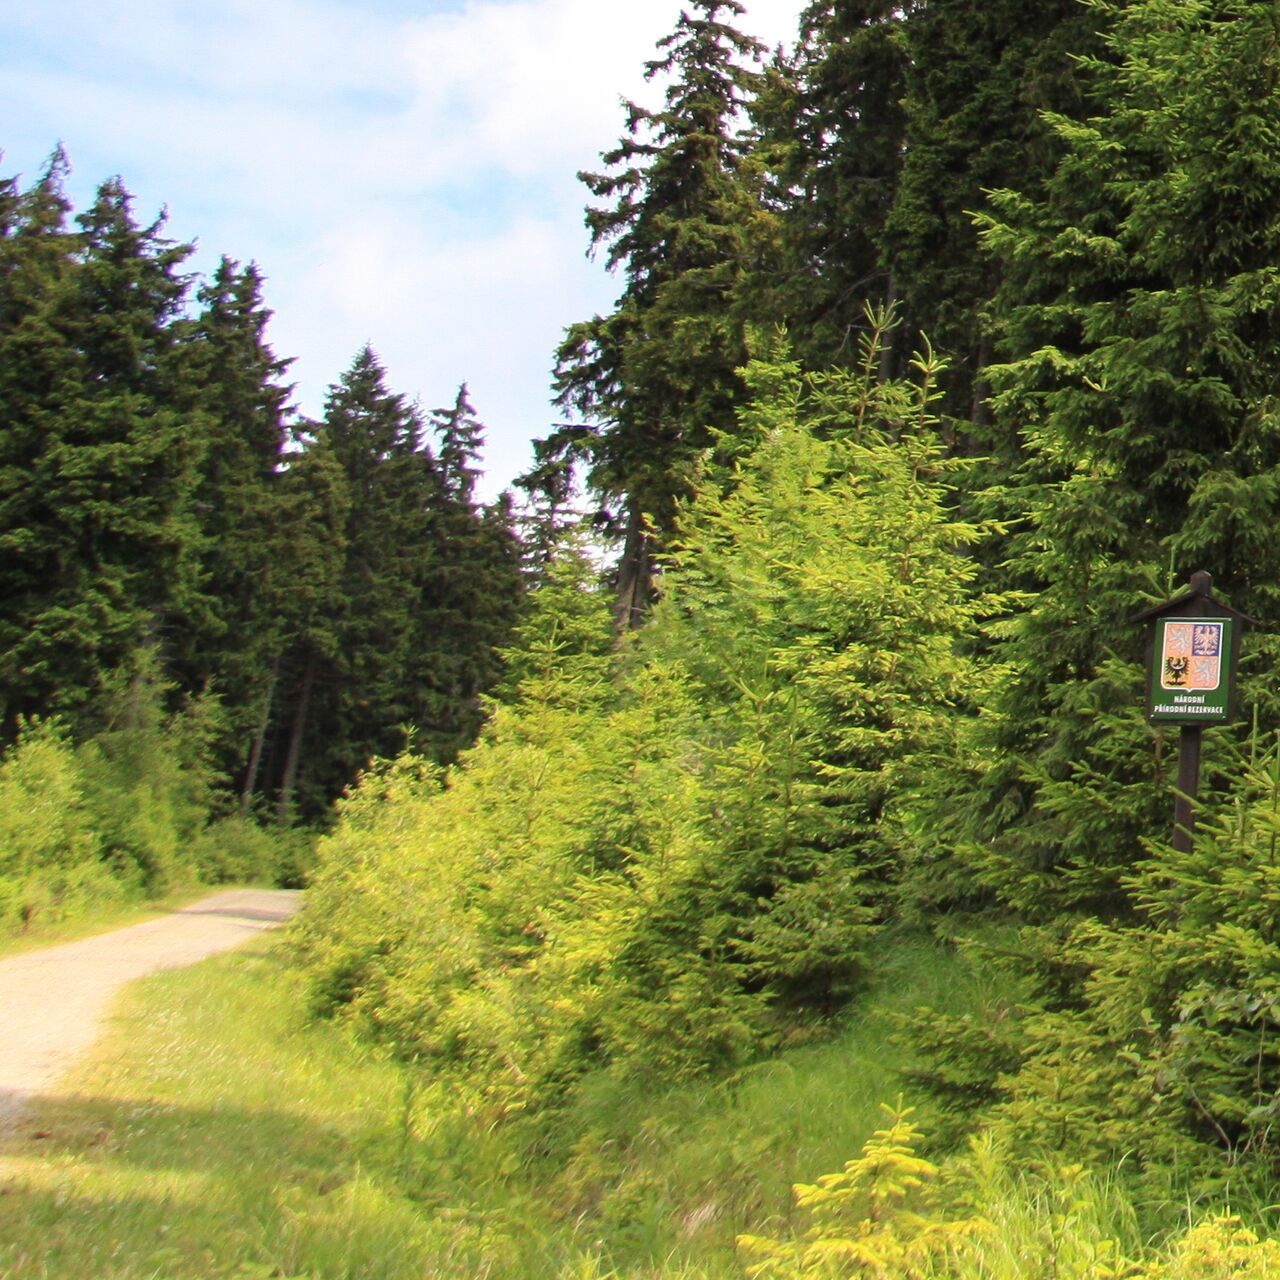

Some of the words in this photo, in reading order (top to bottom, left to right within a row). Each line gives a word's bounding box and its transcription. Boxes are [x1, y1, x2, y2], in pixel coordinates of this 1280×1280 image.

[1174, 695, 1205, 703] NÁRODNÍ
[1154, 704, 1186, 713] PŘÍRODNÍ
[1187, 706, 1223, 714] REZERVACE
